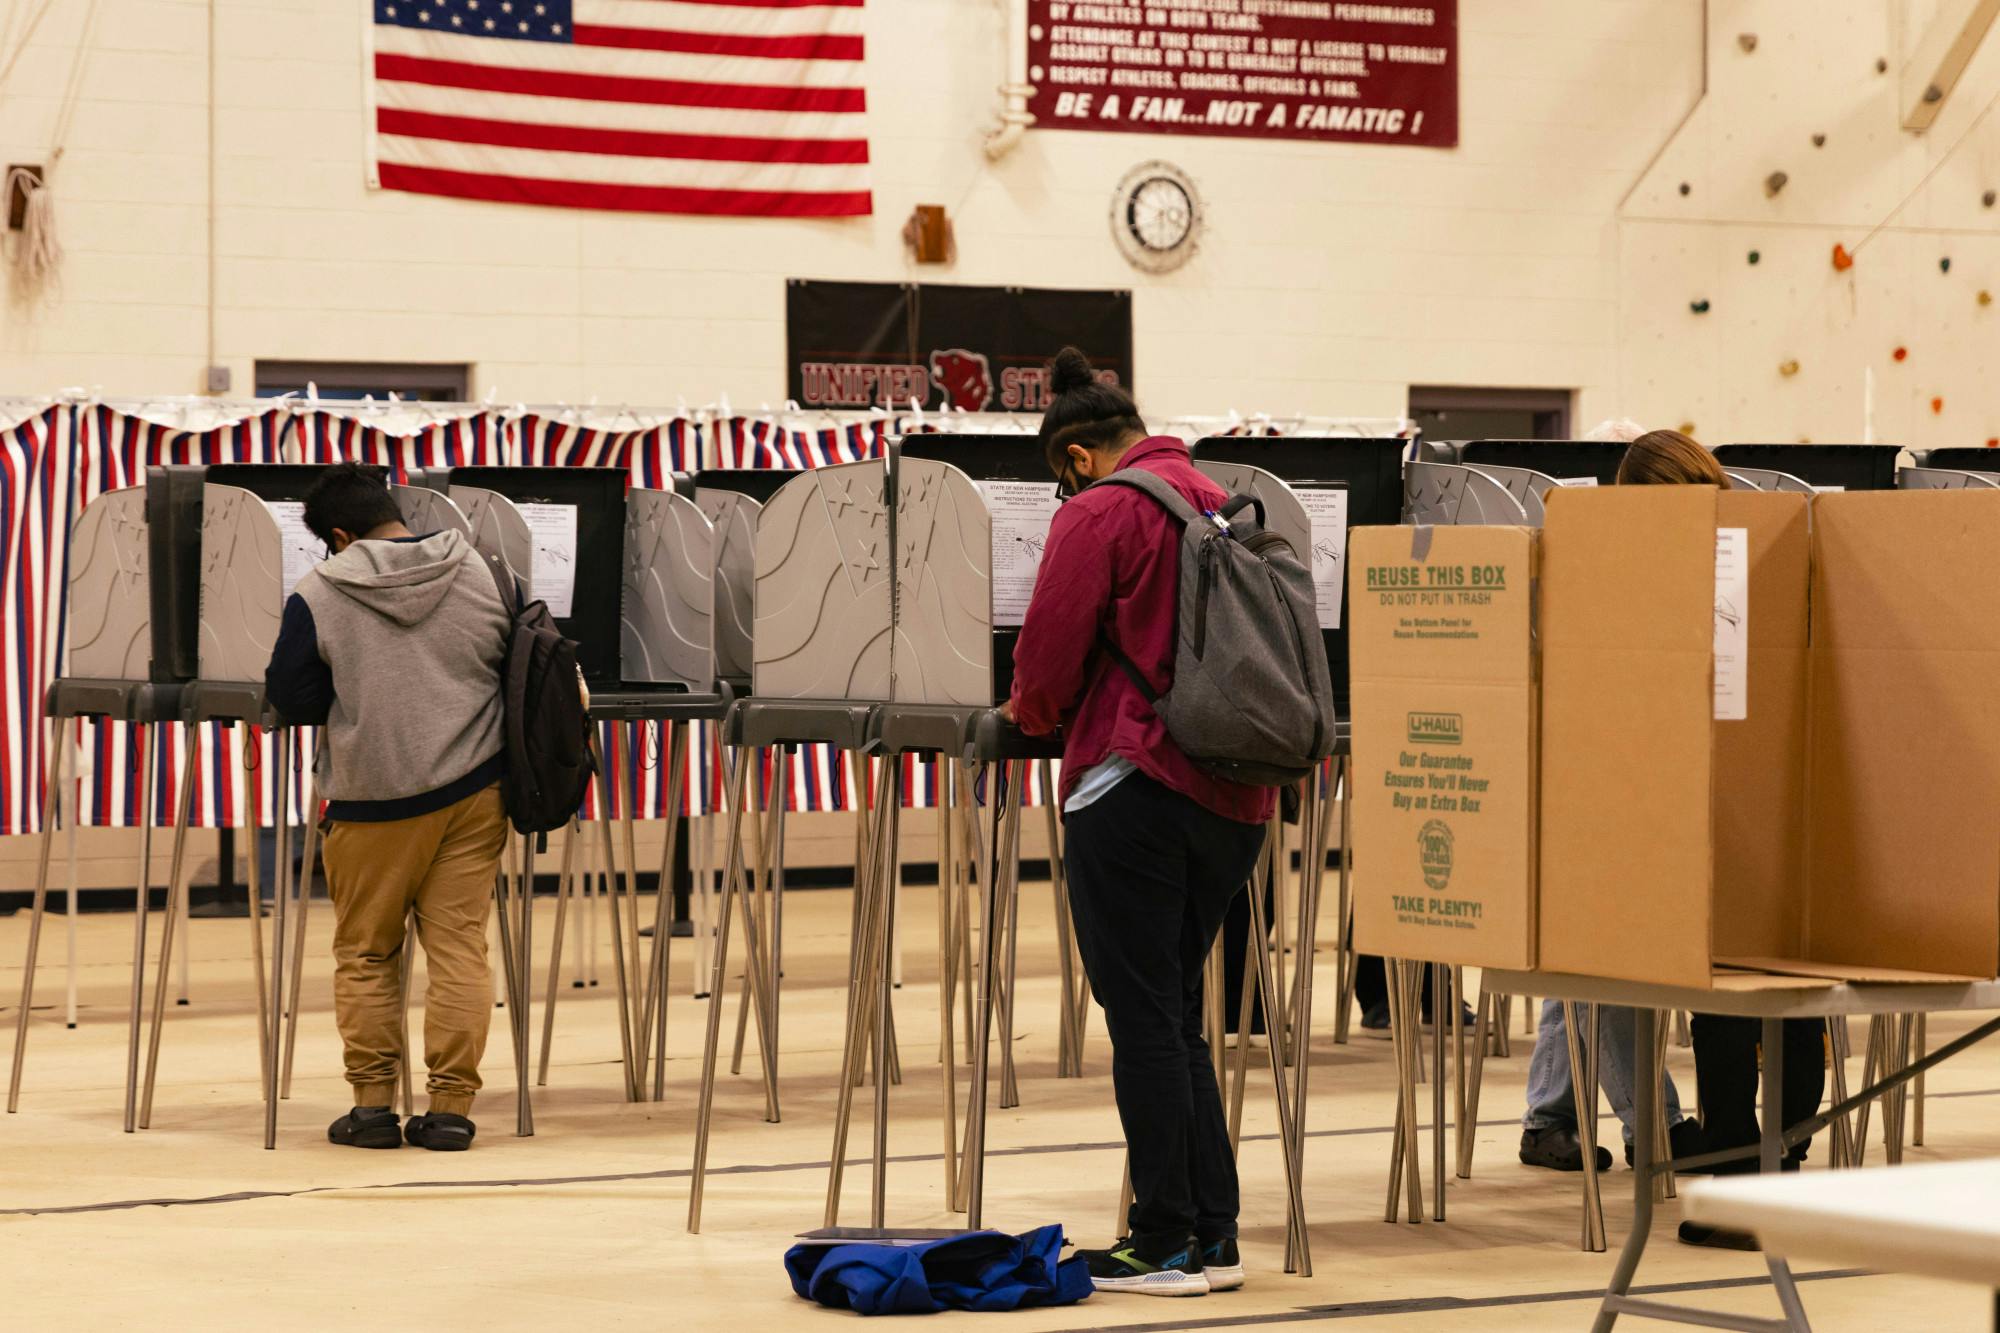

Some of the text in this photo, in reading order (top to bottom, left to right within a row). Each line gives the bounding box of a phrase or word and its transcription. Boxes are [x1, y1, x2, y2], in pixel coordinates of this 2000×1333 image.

[1050, 4, 1070, 20] BY
[1073, 4, 1143, 24] ATHLETES
[1145, 8, 1167, 26] ON
[1170, 9, 1208, 28] BOTH
[1210, 12, 1263, 31] TEAMS.
[1243, 0, 1331, 19] OUTSTANDING
[1334, 3, 1435, 26] PERFORMANCES
[1051, 25, 1447, 64] ATTENDANCE AT THIS CONTEST IS NOT A LICENSE TO VERBALLY
[1050, 43, 1108, 62] ASSAULT
[1111, 46, 1163, 65] OTHERS
[1165, 49, 1184, 66] OR
[1186, 50, 1205, 67] TO
[1207, 51, 1225, 69] BE
[1227, 52, 1297, 72] GENERALLY
[1050, 65, 1108, 85] RESPECT
[1244, 75, 1307, 95] OFFICIALS
[1309, 79, 1321, 97] &
[1323, 80, 1361, 98] FANS.
[1054, 92, 1093, 118] BE
[1099, 95, 1120, 119] A
[1266, 103, 1287, 128] A
[1295, 104, 1406, 134] FANATIC
[1410, 110, 1424, 135] !
[801, 362, 929, 406] UNIFIED
[1367, 566, 1506, 586] REUSE THIS BOX
[1380, 593, 1492, 606] DO NOT PUT IN TRASH
[1393, 630, 1479, 639] Reuse Recommendations
[1400, 618, 1472, 627] See Bottom Panel for
[1399, 751, 1473, 770] Our Guarantee
[1384, 771, 1490, 792] Ensures You'll Never
[1392, 792, 1481, 813] Buy an Extra Box
[1392, 895, 1482, 919] TAKE PLENTY!
